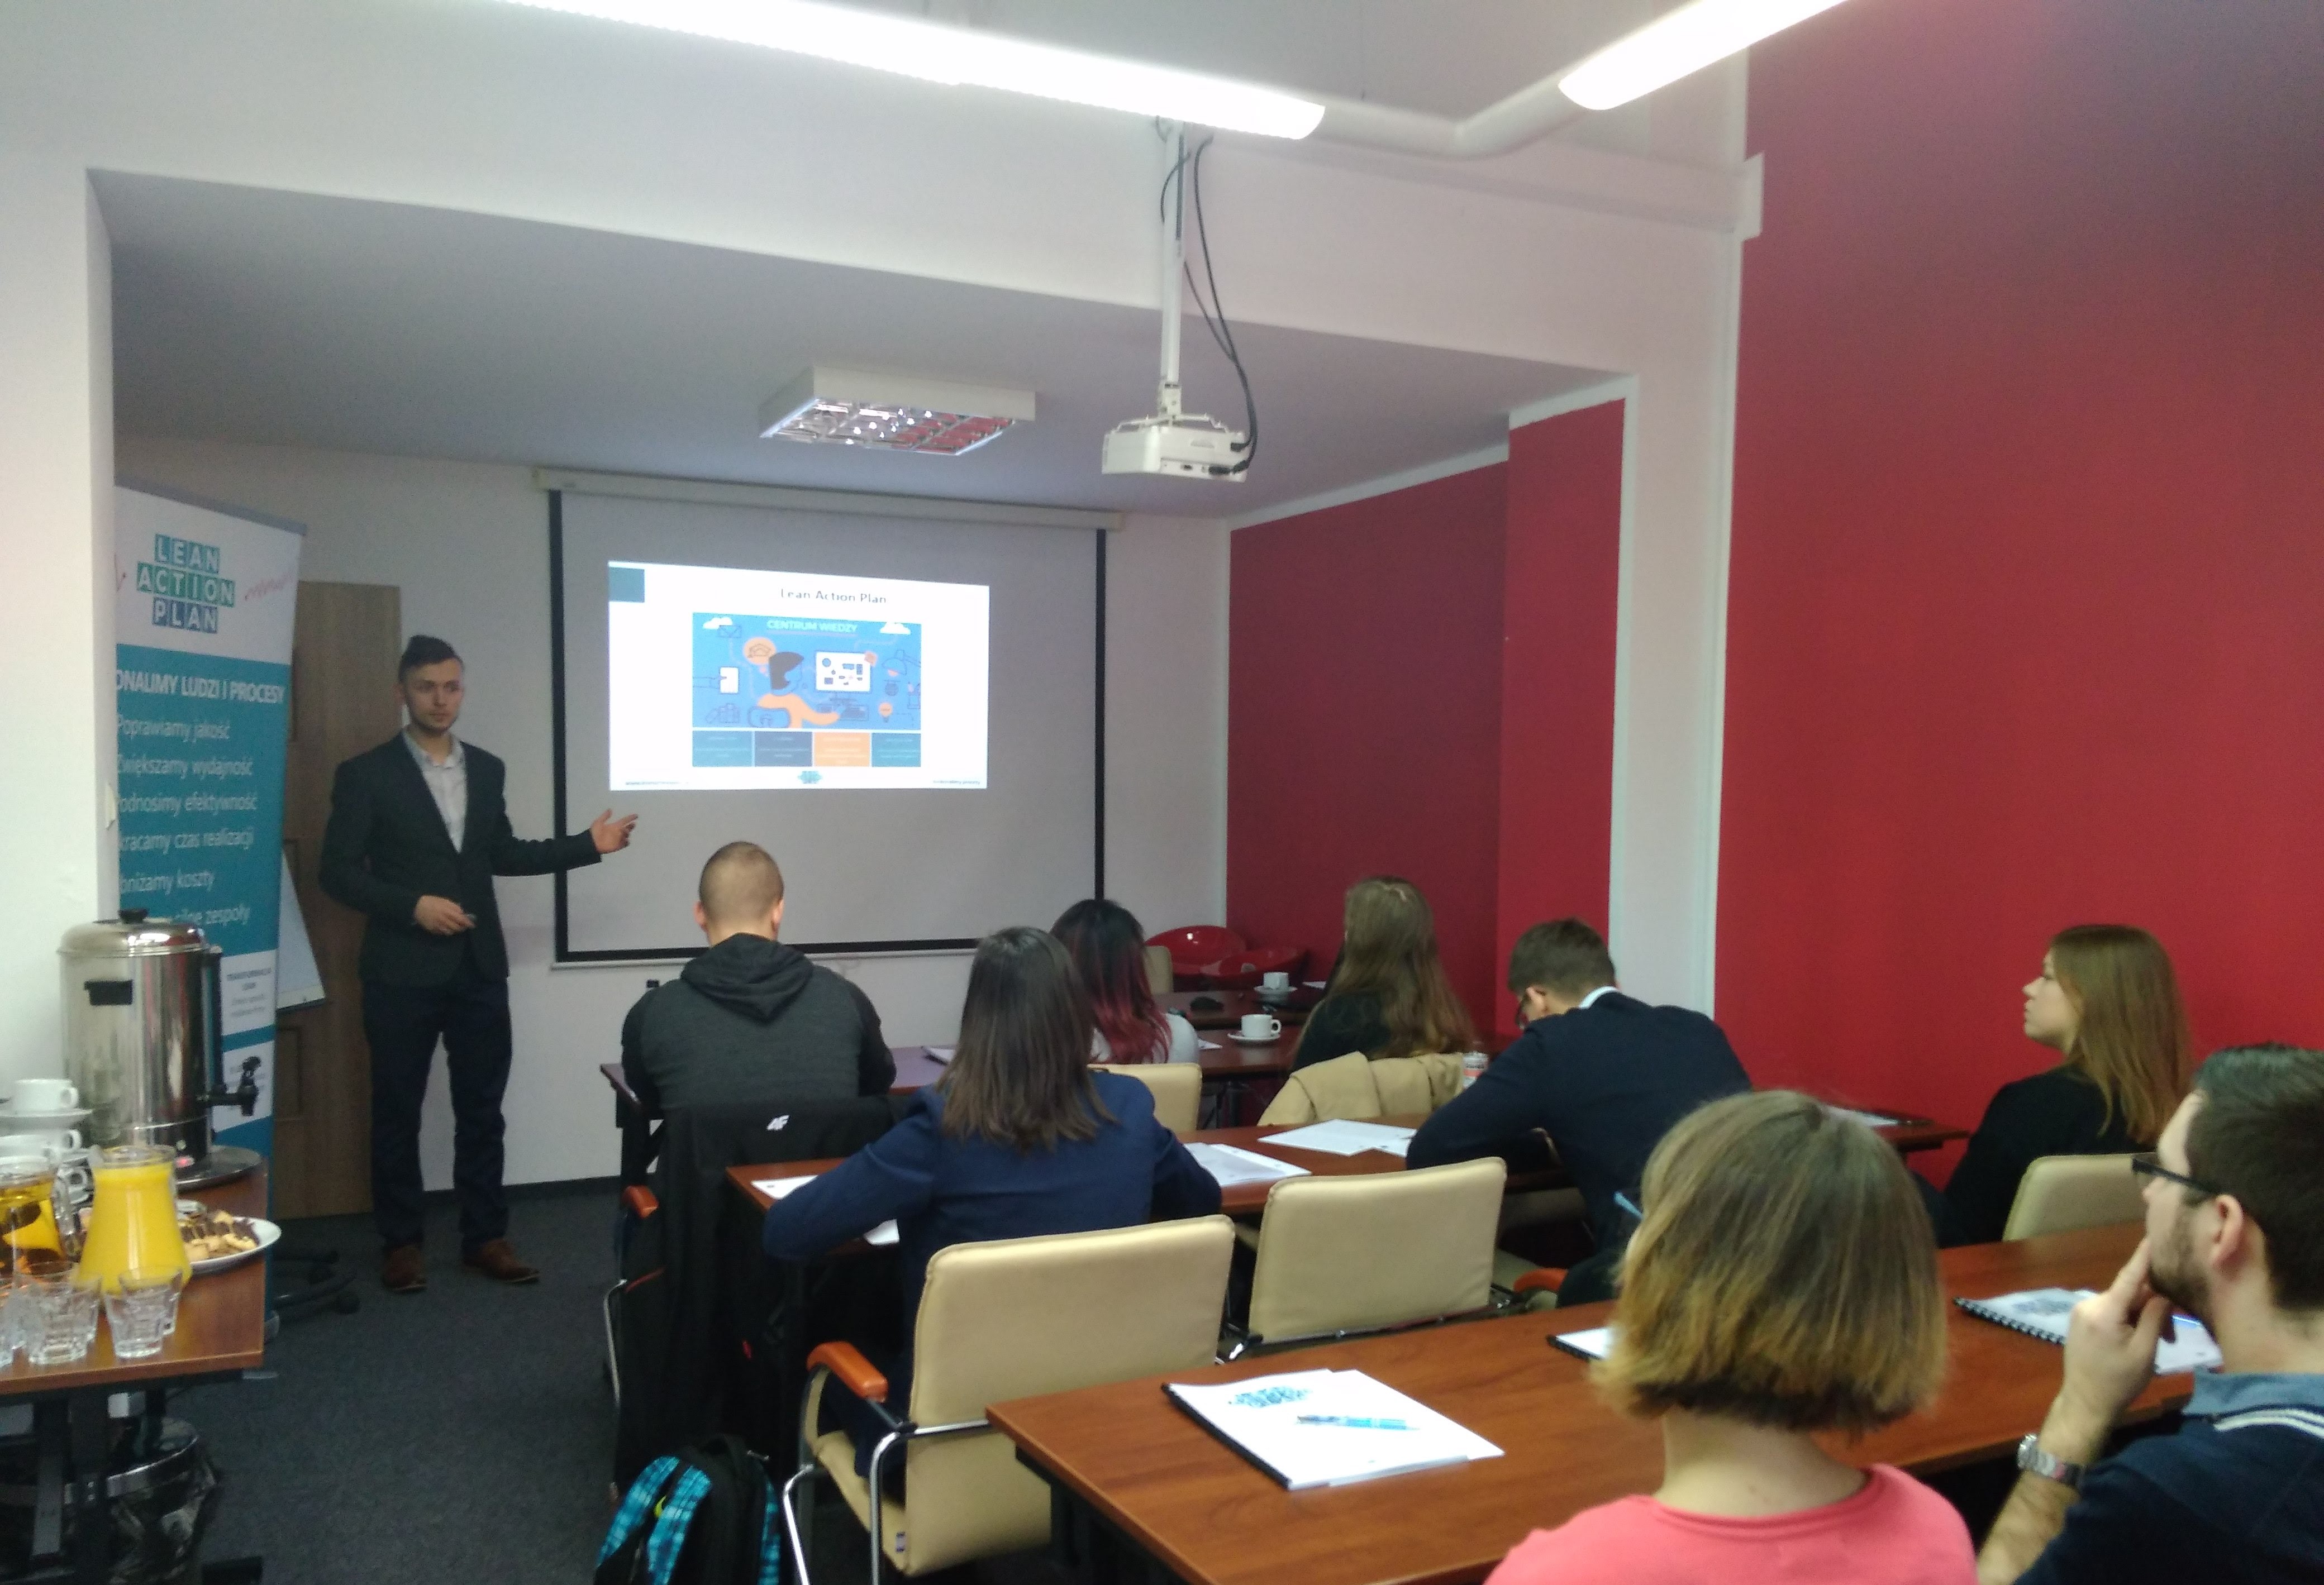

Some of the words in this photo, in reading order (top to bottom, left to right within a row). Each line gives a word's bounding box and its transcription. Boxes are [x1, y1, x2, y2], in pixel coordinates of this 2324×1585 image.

[157, 537, 219, 572] LEAN
[139, 565, 235, 605] ACTION
[781, 588, 810, 599] Lean
[816, 590, 855, 601] Action
[860, 593, 887, 603] Plan
[154, 600, 217, 632] PLAN
[766, 619, 817, 631] CENTRUM
[818, 622, 858, 633] WIEDZY
[181, 676, 220, 699] LUDZI
[118, 792, 182, 817] odnosimy
[174, 833, 201, 848] czas
